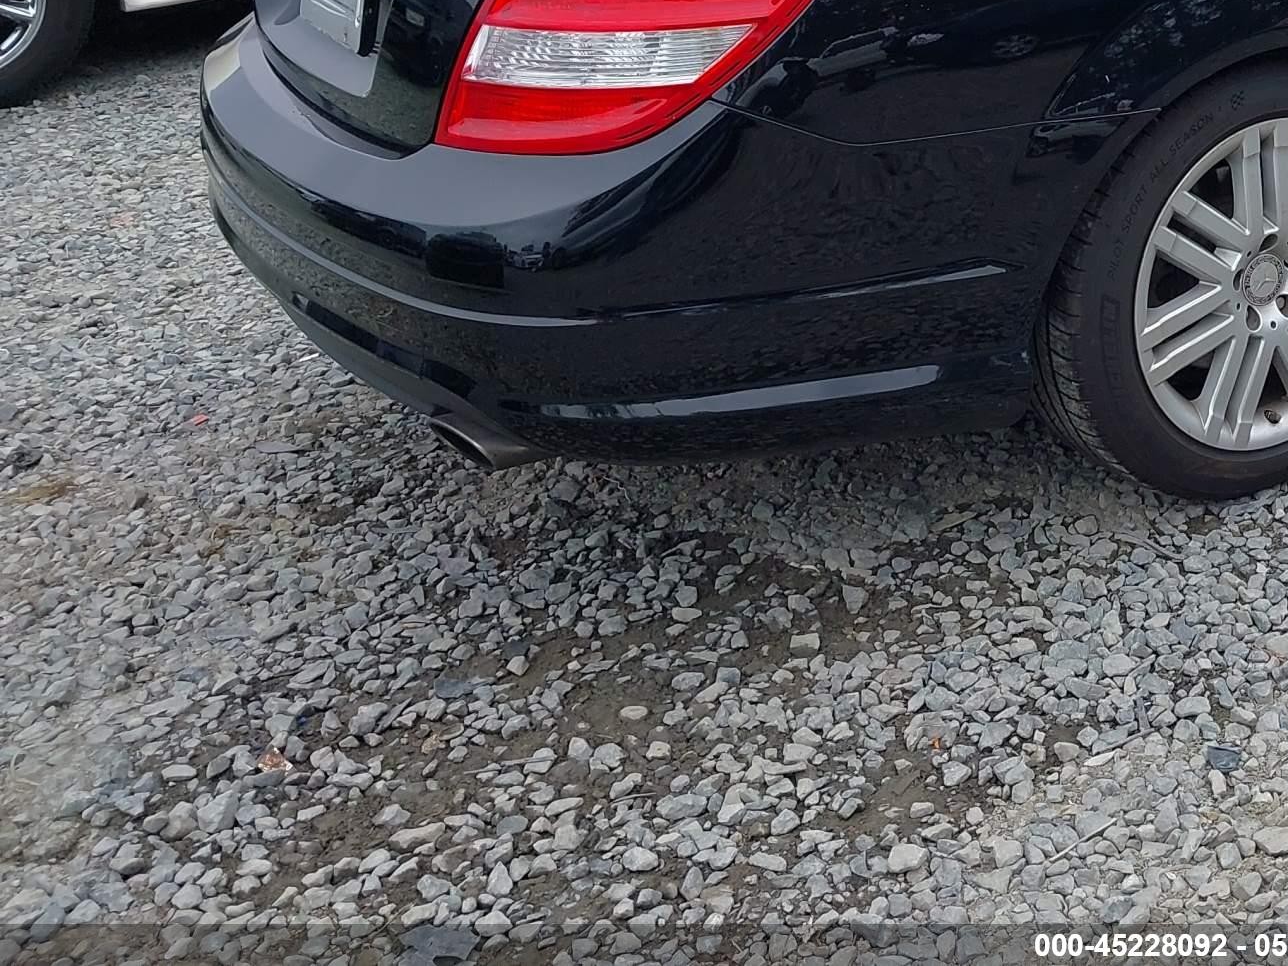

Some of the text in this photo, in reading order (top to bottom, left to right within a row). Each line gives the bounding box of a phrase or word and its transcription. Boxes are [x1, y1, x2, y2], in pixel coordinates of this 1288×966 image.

[1108, 239, 1124, 281] PILOT
[1122, 185, 1148, 233] SPORT
[1150, 158, 1169, 183] ALL
[1168, 113, 1214, 155] SEASON
